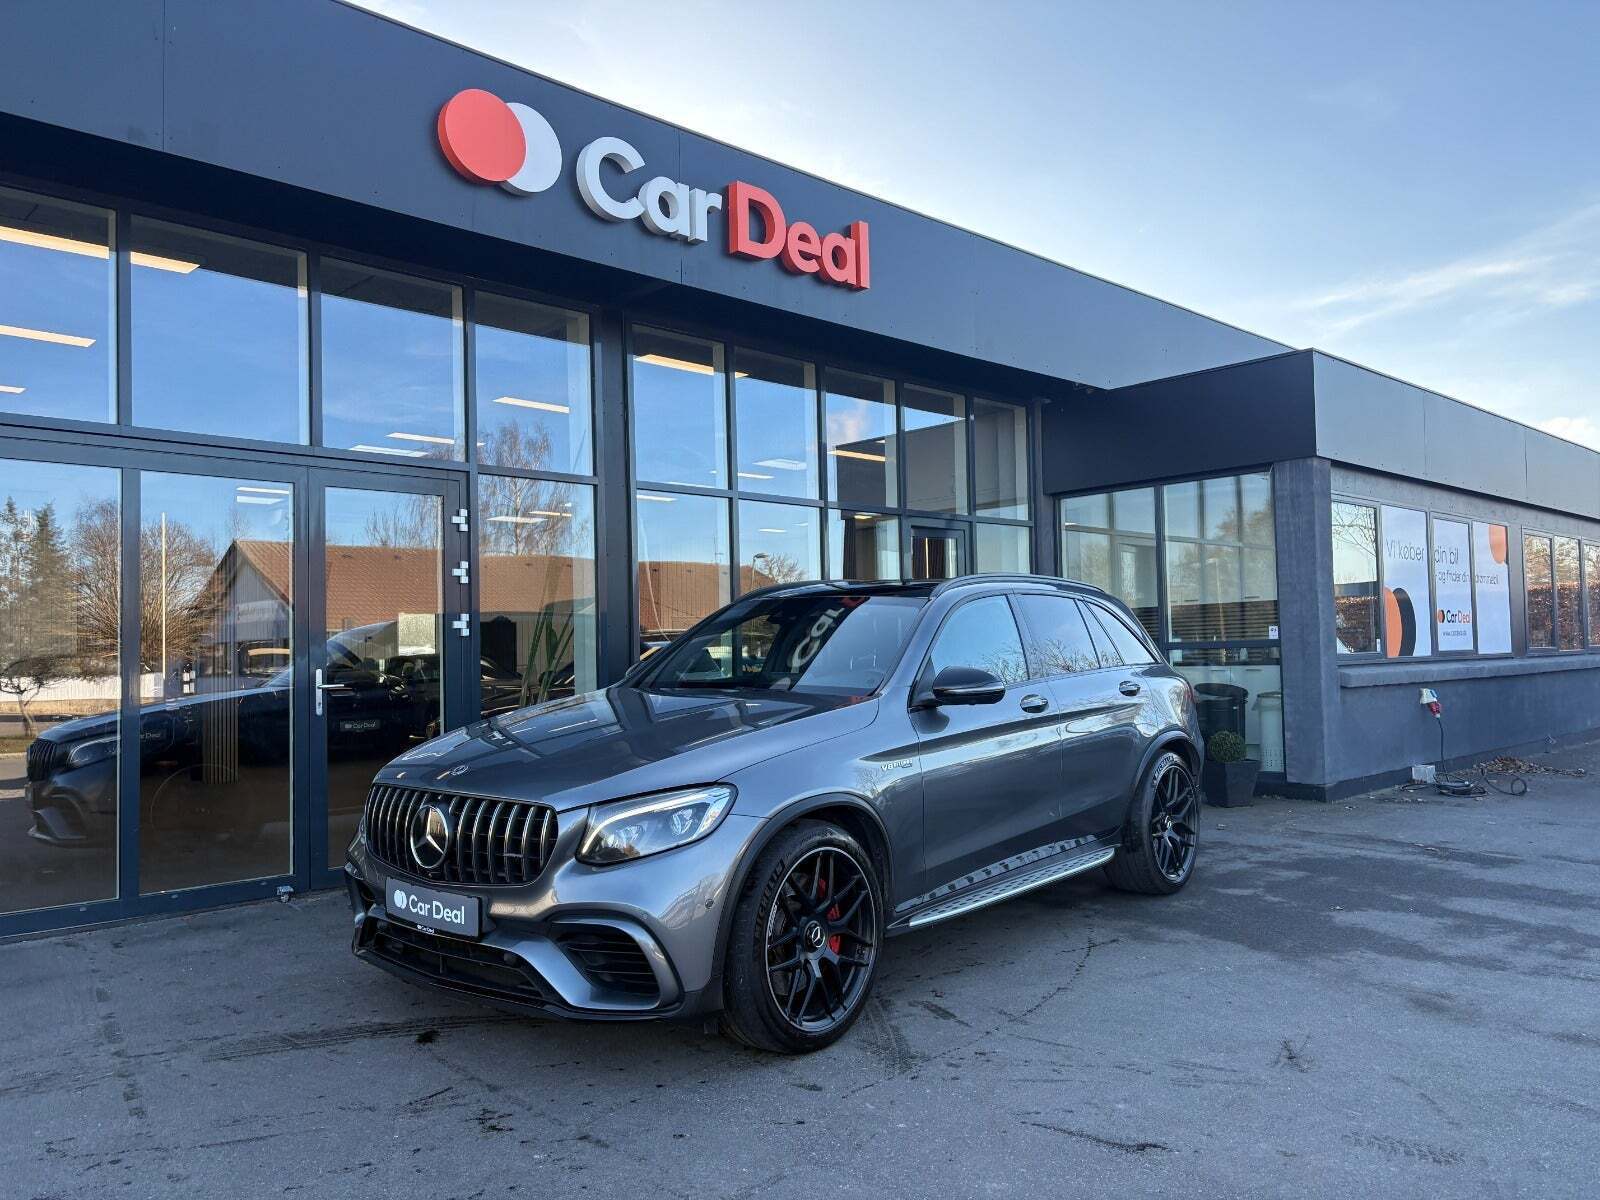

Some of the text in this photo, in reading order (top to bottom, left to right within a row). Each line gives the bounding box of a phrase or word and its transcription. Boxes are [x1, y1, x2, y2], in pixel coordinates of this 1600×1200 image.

[576, 136, 870, 291] Car Deal
[409, 894, 465, 925] Car Deal
